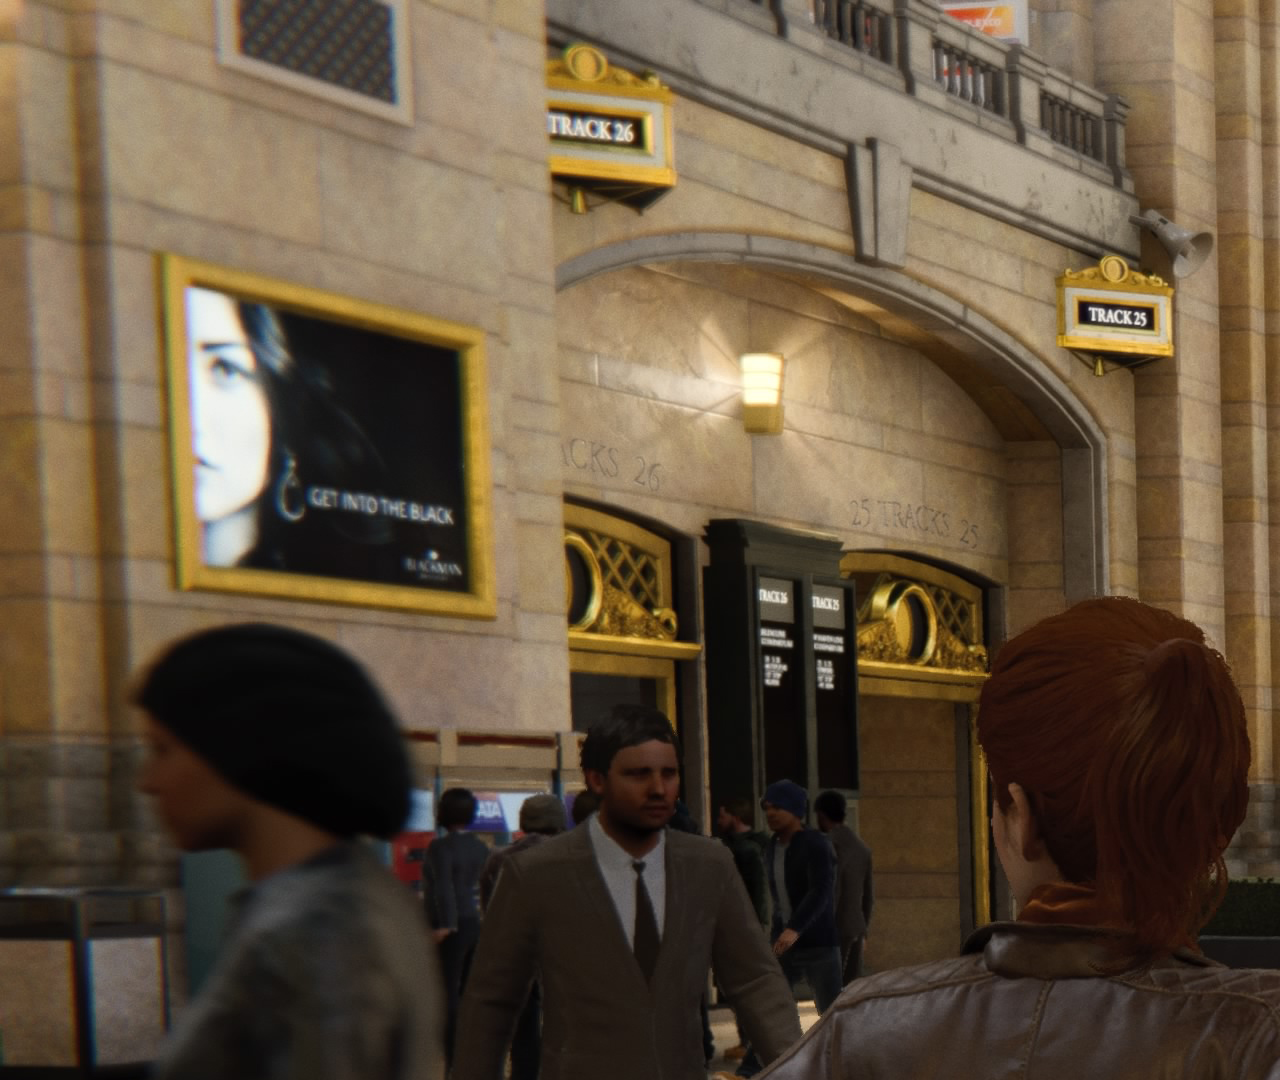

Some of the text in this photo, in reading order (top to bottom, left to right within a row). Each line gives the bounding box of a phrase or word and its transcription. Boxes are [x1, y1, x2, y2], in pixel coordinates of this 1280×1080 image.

[549, 113, 634, 143] TRACK 26
[1088, 306, 1148, 327] TRACK 25
[634, 455, 662, 492] 26
[311, 487, 455, 526] GET INTO THE BLACK
[850, 498, 979, 549] 25 TRACKS 25
